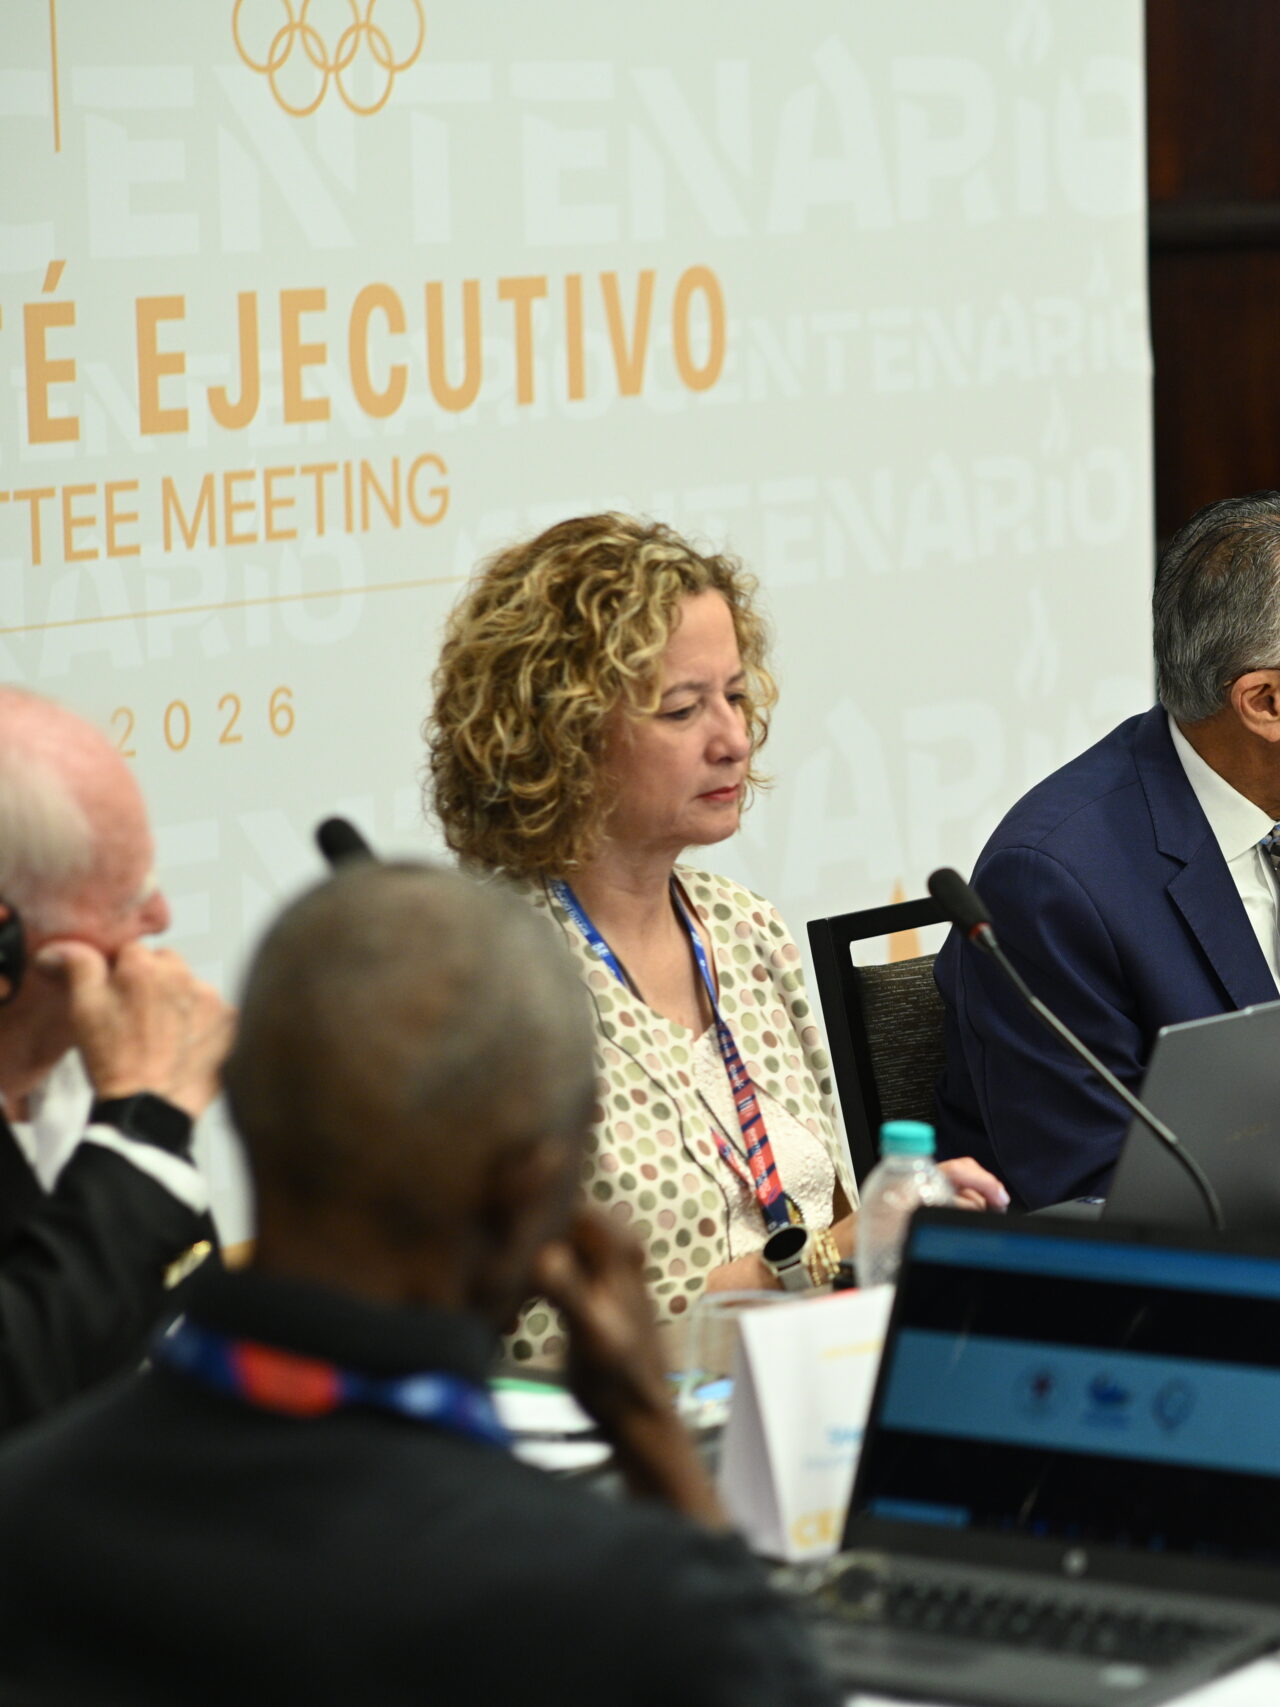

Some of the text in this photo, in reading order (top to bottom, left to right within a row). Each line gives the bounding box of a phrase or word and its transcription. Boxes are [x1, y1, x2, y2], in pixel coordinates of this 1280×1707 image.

[135, 264, 727, 436] EJECUTIVO
[162, 451, 451, 554] MEETING
[110, 685, 296, 759] 2026
